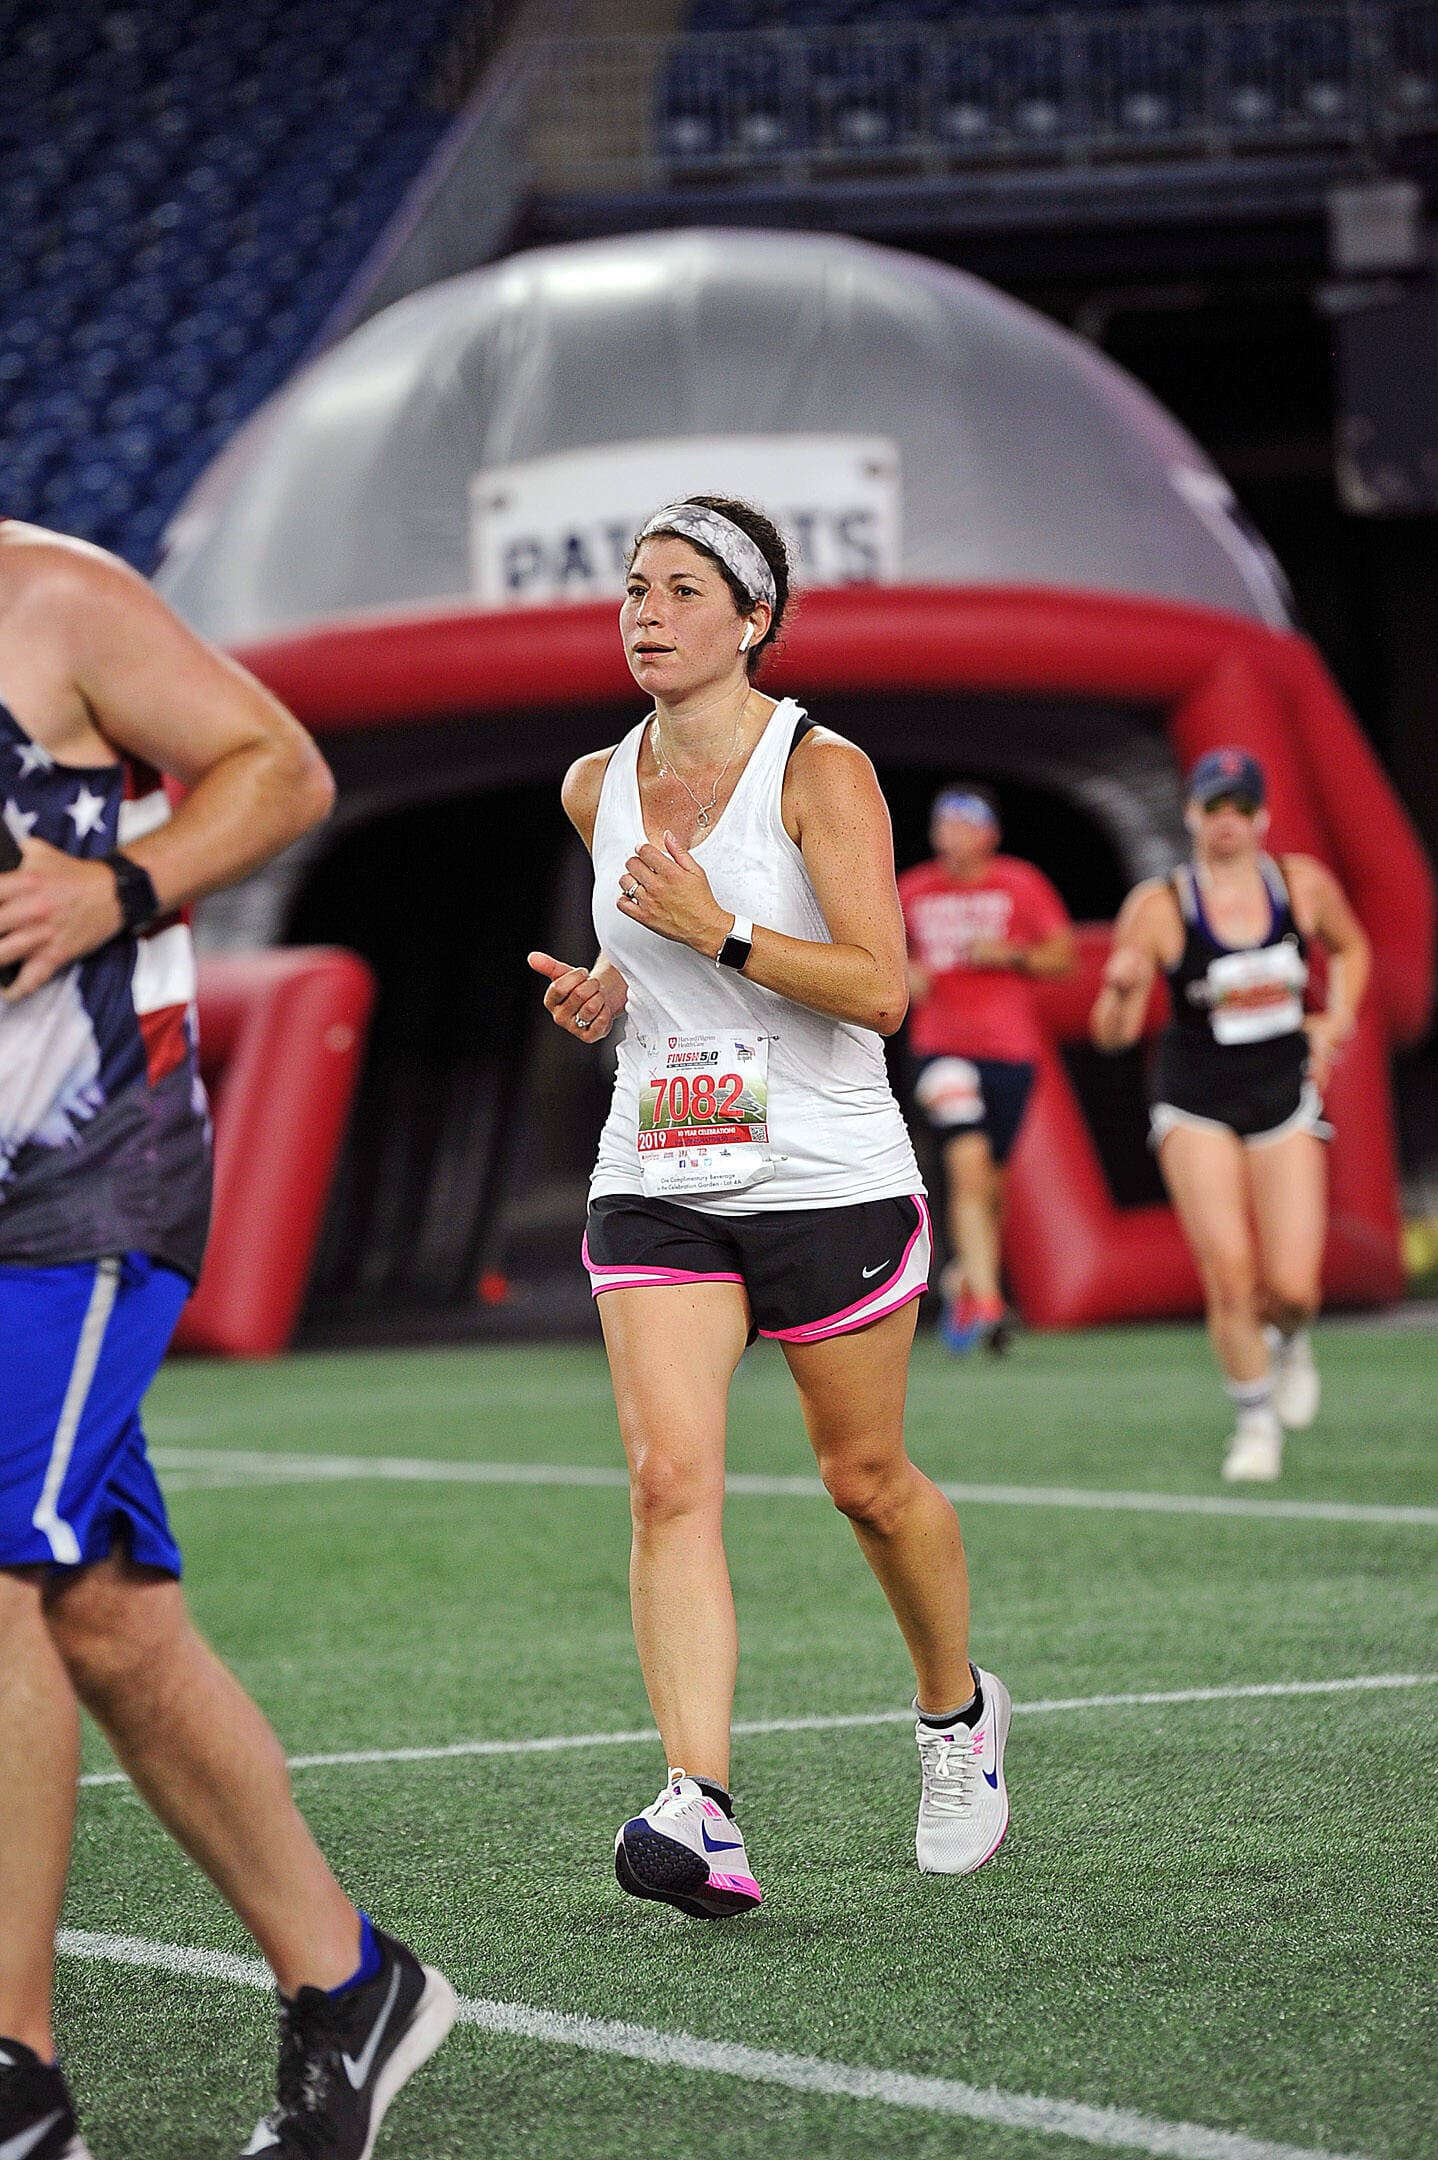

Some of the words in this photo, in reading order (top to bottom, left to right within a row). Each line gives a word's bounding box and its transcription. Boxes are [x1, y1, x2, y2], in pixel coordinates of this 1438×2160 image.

[503, 506, 878, 590] PATTS
[667, 1052, 699, 1063] FINISH
[650, 1073, 744, 1122] 7082
[639, 1131, 667, 1150] 2019
